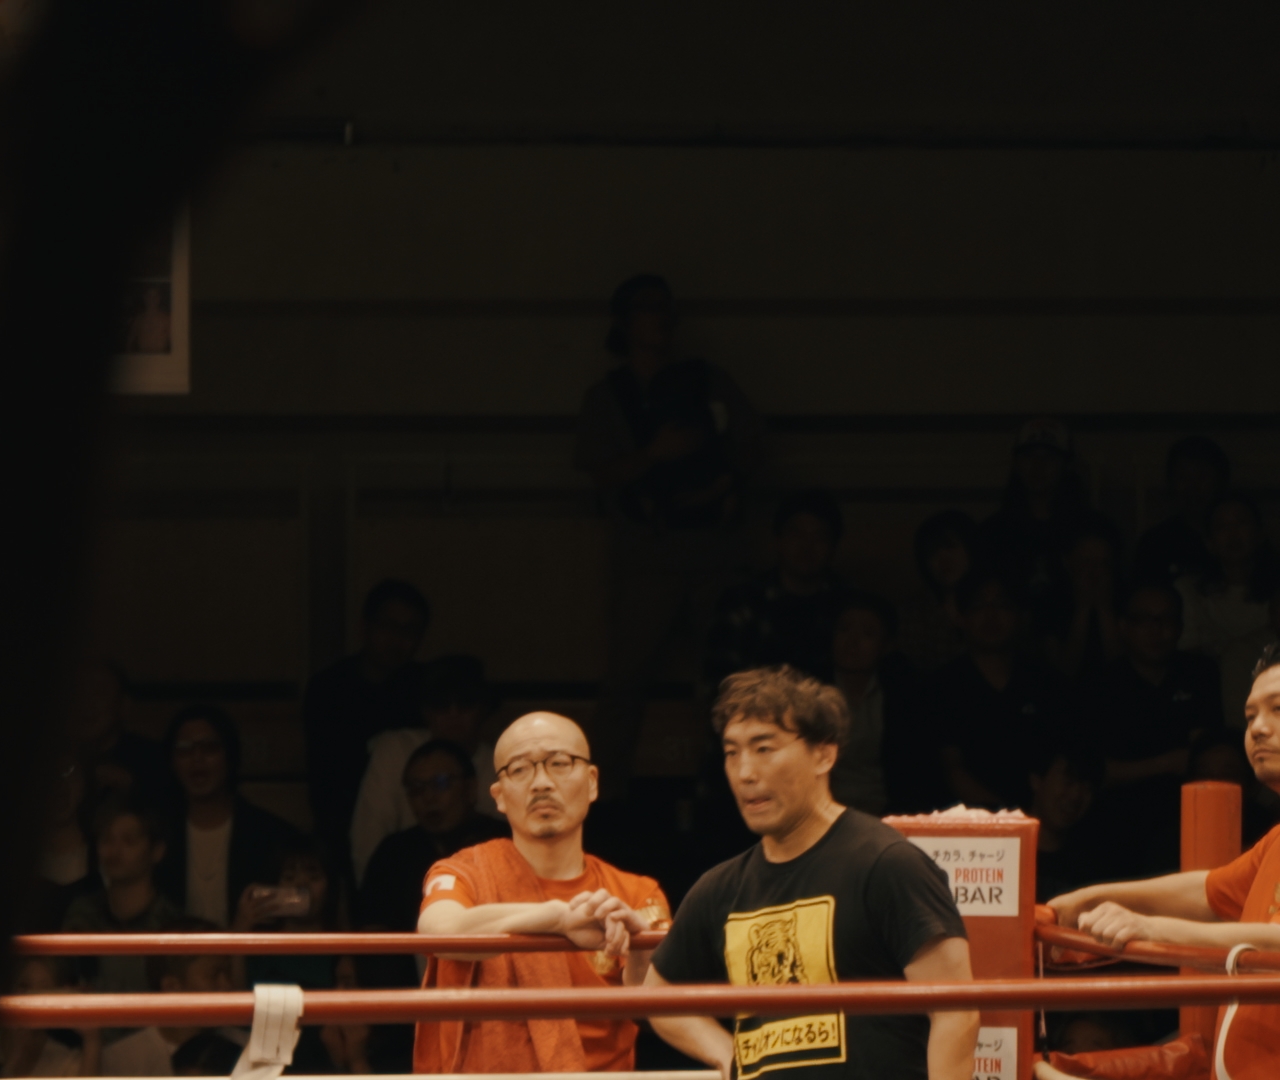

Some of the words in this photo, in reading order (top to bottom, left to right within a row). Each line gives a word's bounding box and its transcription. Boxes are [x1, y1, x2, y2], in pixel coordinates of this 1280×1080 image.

[955, 867, 1004, 883] PROTEIN
[955, 886, 1004, 904] BAR
[974, 1057, 1002, 1074] TEIN
